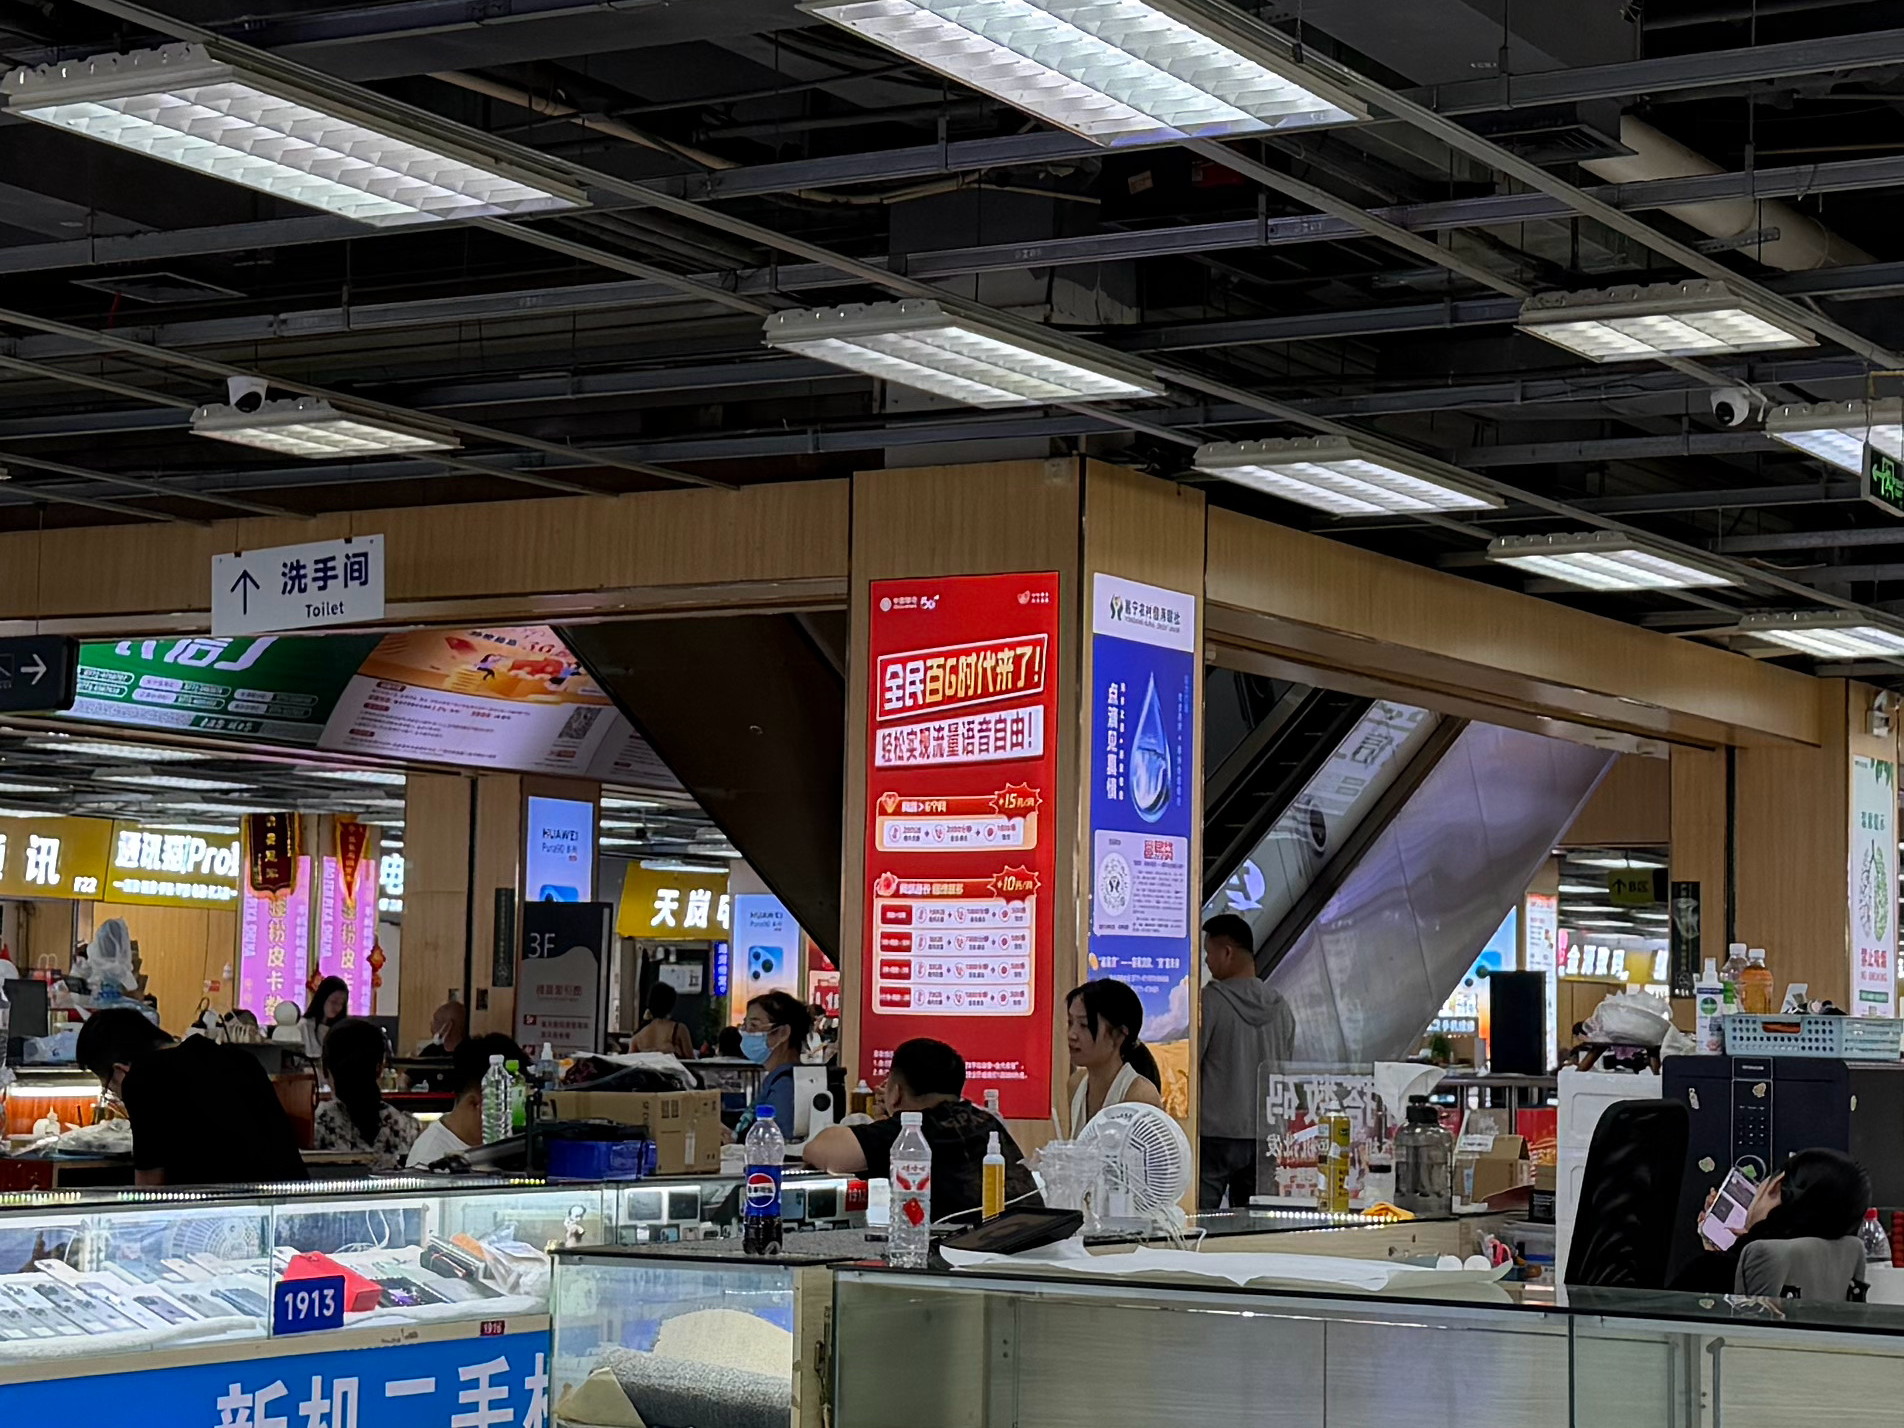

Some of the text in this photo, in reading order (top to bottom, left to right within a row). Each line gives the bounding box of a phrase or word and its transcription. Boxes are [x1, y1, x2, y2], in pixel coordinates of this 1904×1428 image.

[280, 550, 371, 596] 洗手间
[305, 599, 345, 619] Toilet
[528, 933, 555, 959] 3F
[284, 1288, 336, 1322] 1913
